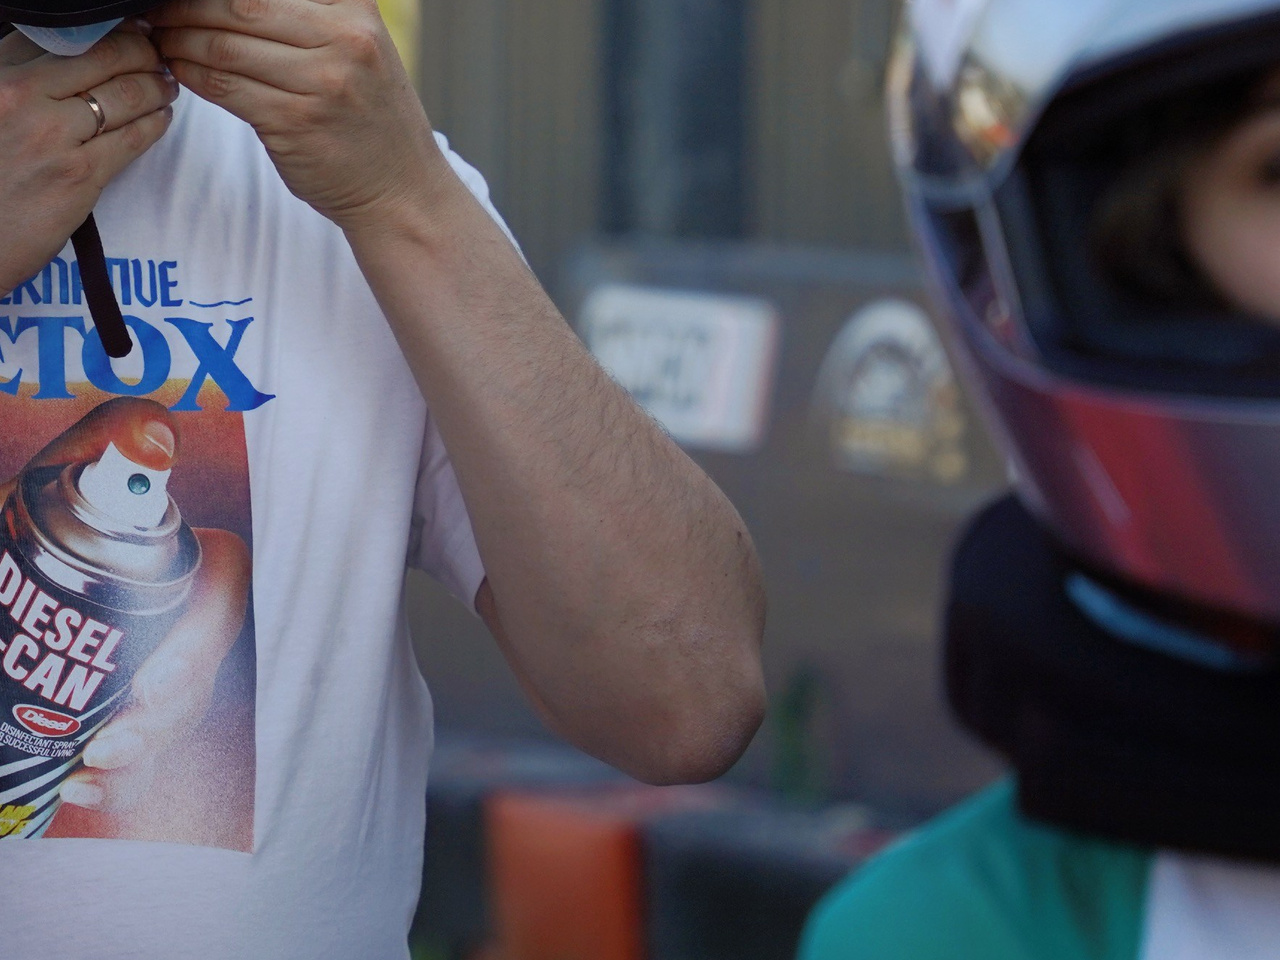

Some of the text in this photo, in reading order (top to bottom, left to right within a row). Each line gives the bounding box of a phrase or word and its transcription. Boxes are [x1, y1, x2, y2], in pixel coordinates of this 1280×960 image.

[22, 709, 74, 731] Diesel
[0, 721, 77, 750] DISINFECTANT SPRAY
[3, 734, 51, 757] SUCCESSFUL
[50, 748, 76, 758] LIVING
